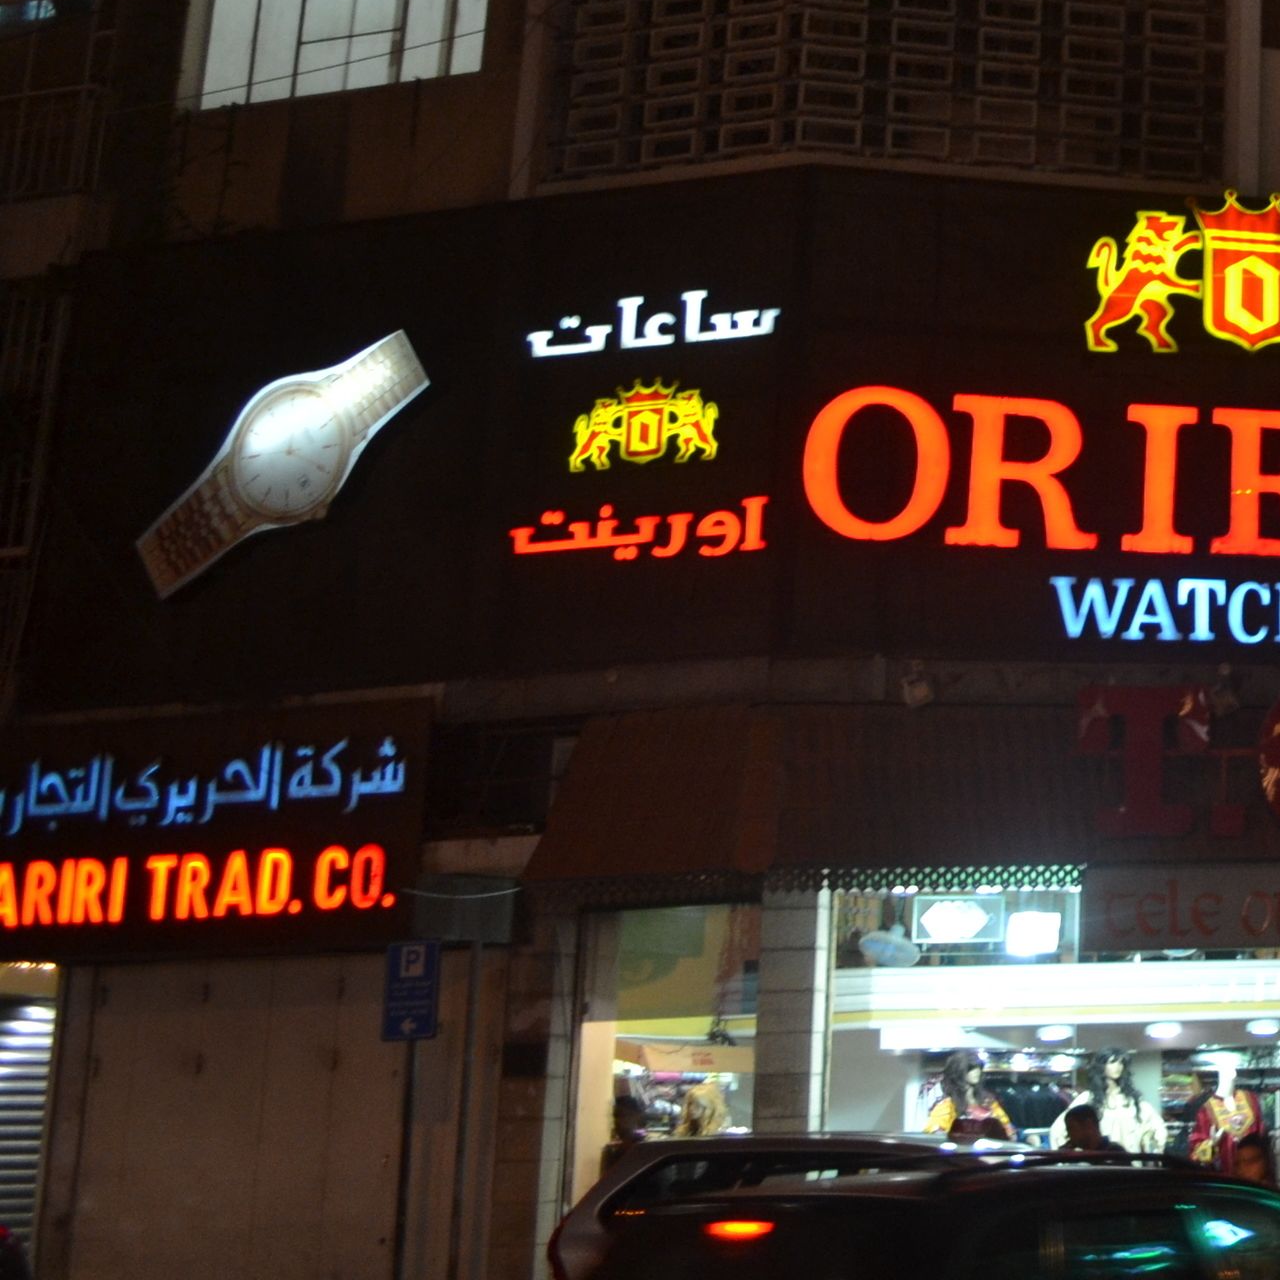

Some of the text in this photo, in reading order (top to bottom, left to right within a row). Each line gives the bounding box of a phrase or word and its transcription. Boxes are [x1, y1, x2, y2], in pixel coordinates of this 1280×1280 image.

[526, 289, 781, 358] ساعات
[509, 495, 769, 561] اورينت
[0, 736, 407, 837] شركة الحريري التجار
[146, 846, 302, 921] TRAD.
[312, 843, 396, 910] CO.
